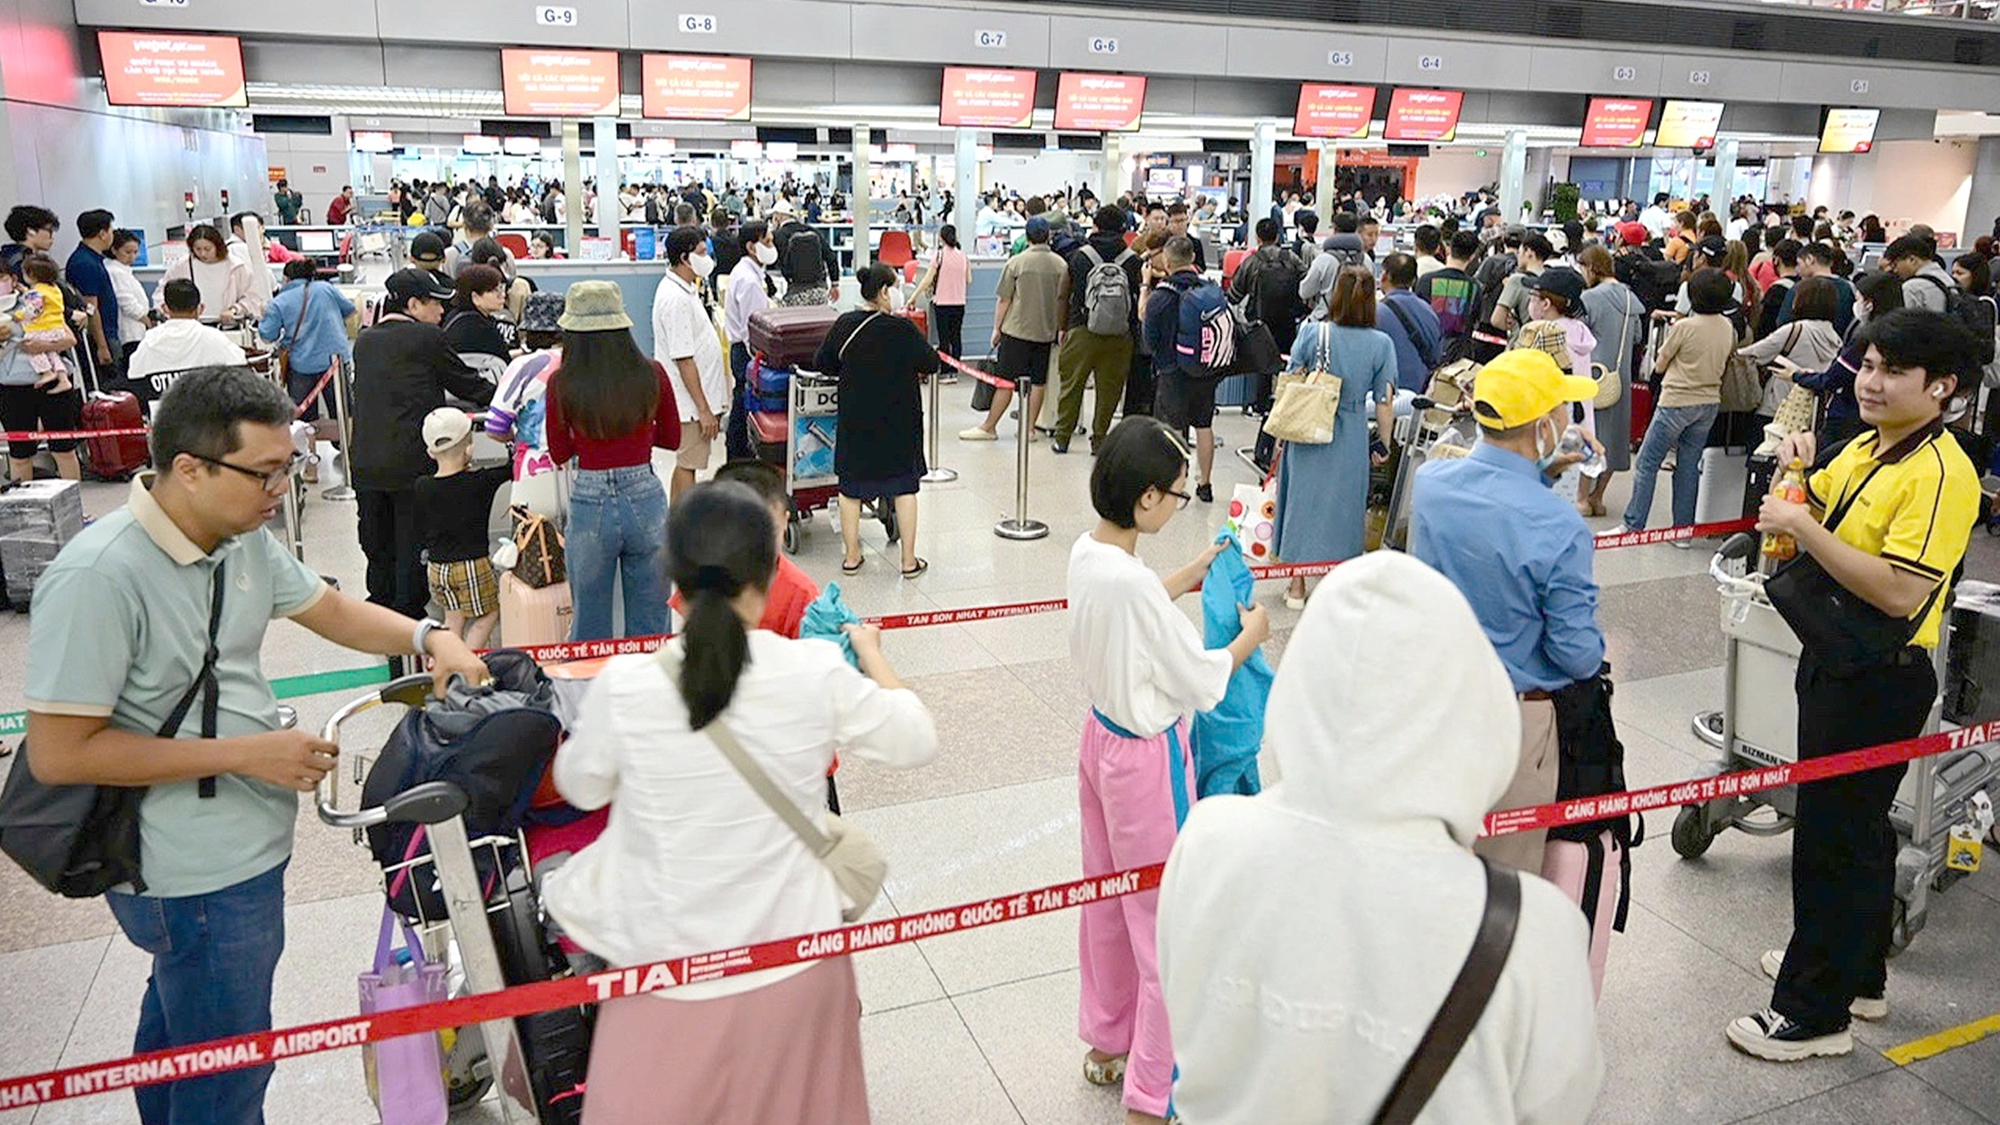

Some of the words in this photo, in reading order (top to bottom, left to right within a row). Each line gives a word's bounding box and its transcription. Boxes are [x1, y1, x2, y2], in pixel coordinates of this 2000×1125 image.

[544, 9, 572, 23] G-9
[686, 17, 712, 30] G-8
[981, 32, 1003, 45] G-7
[1094, 39, 1115, 52] G-6
[1332, 53, 1350, 65] G-5
[1422, 57, 1439, 68] G-4
[1617, 68, 1633, 79] G-3
[1692, 72, 1708, 83] G-2
[1253, 569, 1266, 579] ON
[907, 615, 929, 625] TAN
[931, 613, 952, 624] SON
[956, 609, 984, 621] NHAT
[538, 648, 569, 660] QUỐC
[573, 643, 588, 657] TẾ
[618, 640, 640, 652] SƠN
[644, 637, 668, 652] NHẤ
[1948, 725, 1986, 750] TIA
[1598, 796, 1628, 814] HÀNG
[1631, 789, 1667, 809] KHÔNG
[1670, 781, 1698, 802] QUỐC
[1702, 778, 1716, 797] TẾ
[1718, 775, 1738, 794] TÂN
[1740, 772, 1760, 791] SƠN
[1763, 766, 1791, 786] NHẤT
[850, 924, 895, 949] HÀNG
[901, 912, 956, 939] KHÔNG
[961, 900, 1003, 926] QUỐC
[1008, 893, 1028, 917] TẾ
[1032, 889, 1063, 912] TÂN
[1068, 882, 1097, 905] SƠN
[1101, 871, 1140, 897] NHẤT
[588, 963, 677, 1001] TIA
[0, 1079, 55, 1108] HAT
[64, 1041, 263, 1097] INTERNATIONAL
[271, 1021, 371, 1058] AIRPORT
